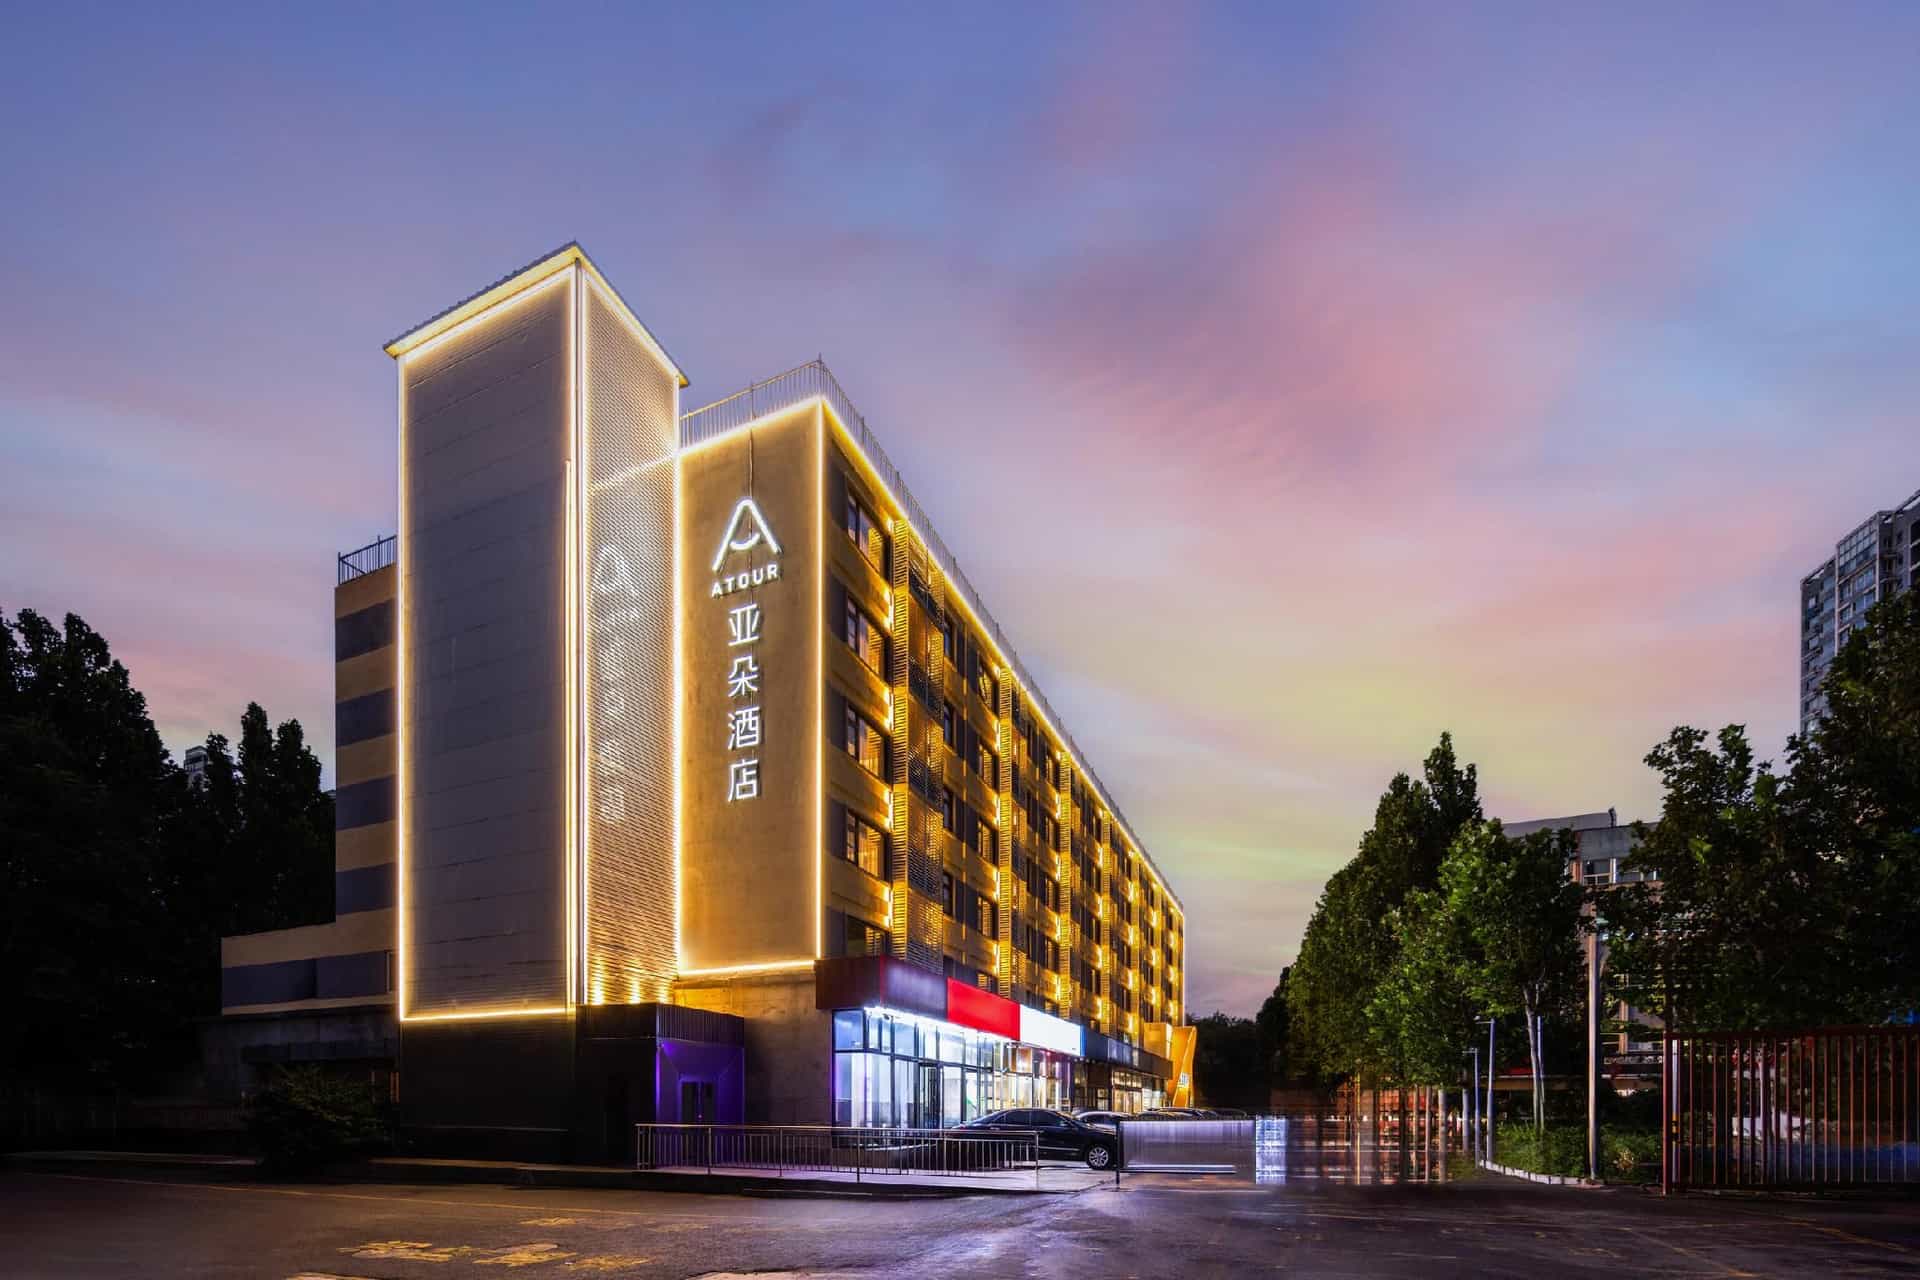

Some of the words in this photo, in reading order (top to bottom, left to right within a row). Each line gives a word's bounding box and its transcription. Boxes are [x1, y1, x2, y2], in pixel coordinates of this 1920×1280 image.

[711, 563, 779, 598] ATOUR
[728, 603, 760, 802] 亚朵酒店
